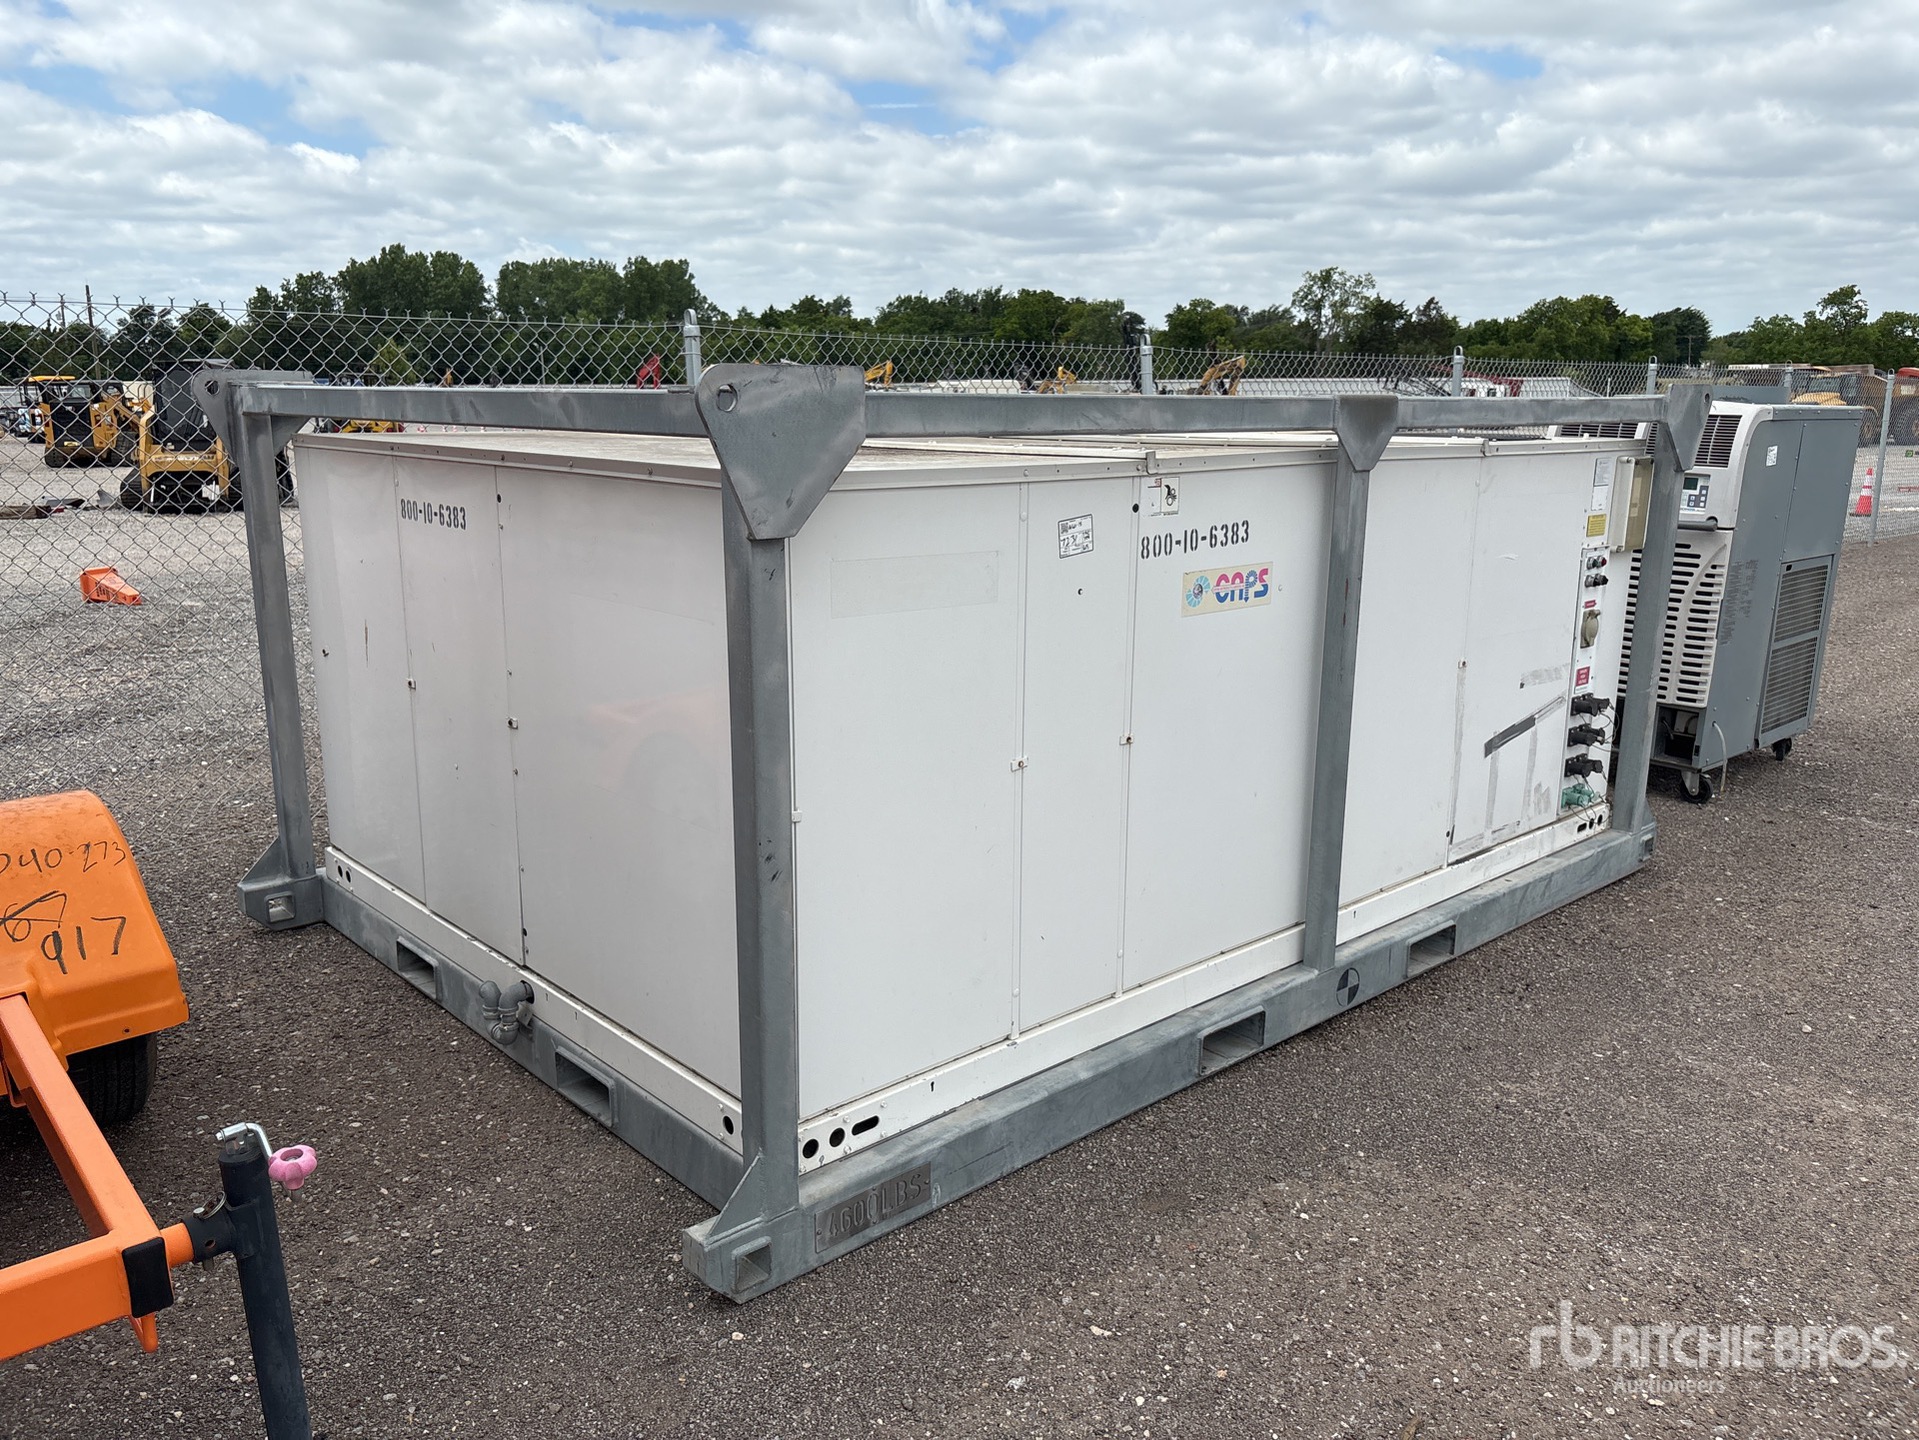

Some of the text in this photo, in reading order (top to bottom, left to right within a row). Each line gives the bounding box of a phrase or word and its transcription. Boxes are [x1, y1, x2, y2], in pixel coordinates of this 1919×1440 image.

[400, 498, 467, 531] 800-10-6383
[1140, 519, 1250, 560] 800-10-6383
[1214, 567, 1269, 604] CAPS
[41, 916, 127, 975] 917
